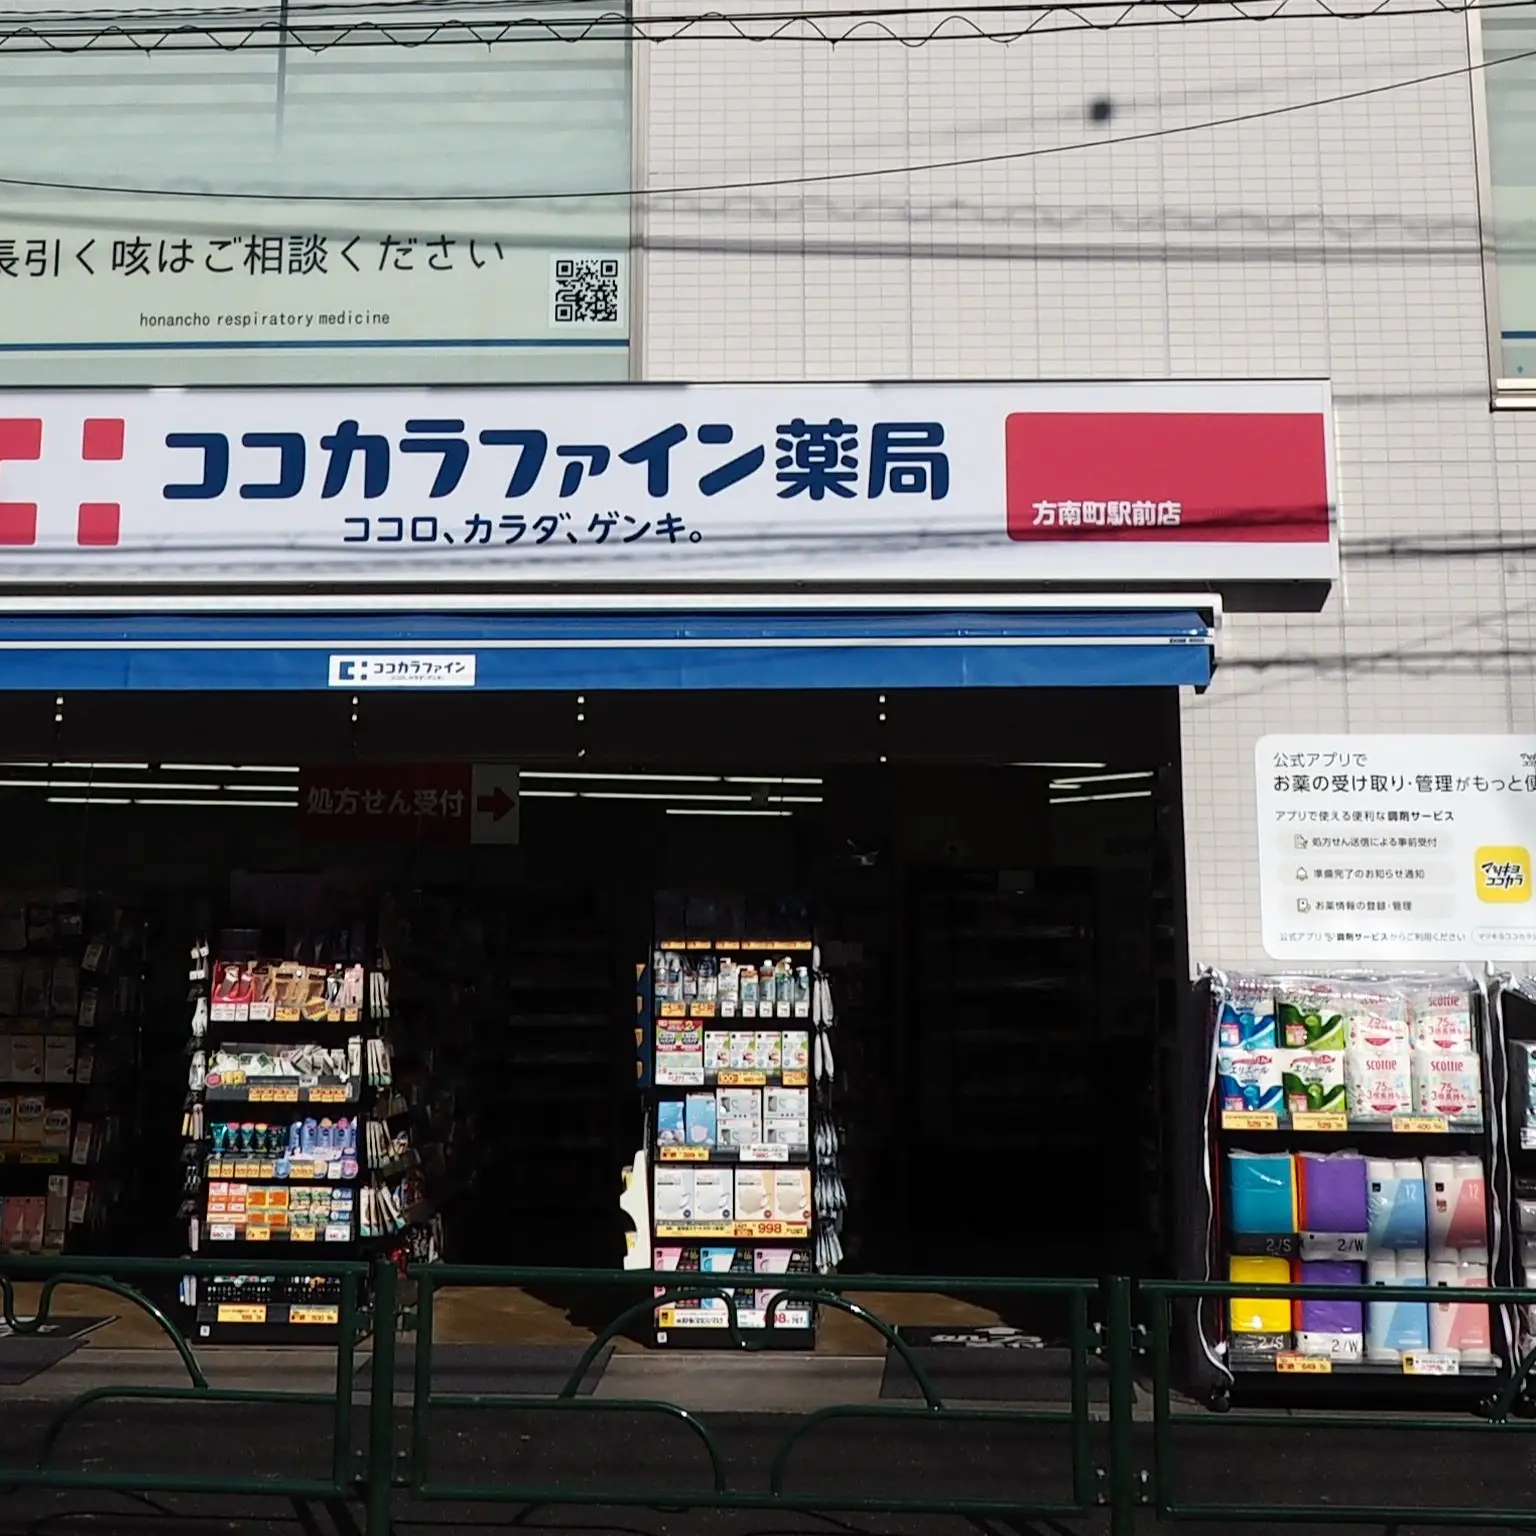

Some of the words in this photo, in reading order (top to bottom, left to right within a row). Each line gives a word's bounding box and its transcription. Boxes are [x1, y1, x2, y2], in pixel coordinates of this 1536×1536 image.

[139, 310, 211, 329] honancho
[216, 309, 314, 328] respiratory
[318, 307, 390, 326] medicine
[162, 417, 952, 503] ココカラファイン薬局
[1031, 498, 1184, 528] 方南町駅前店
[342, 511, 704, 545] ココロ、カラダ、ゲンキ。
[373, 661, 466, 674] ココカラファイン
[1273, 751, 1368, 769] 公式アプリで
[306, 786, 466, 817] 処方せん受付
[1485, 873, 1524, 889] ココカラ
[1365, 1059, 1398, 1071] scottie
[1430, 1060, 1464, 1072] scottie
[757, 1223, 783, 1234] 998
